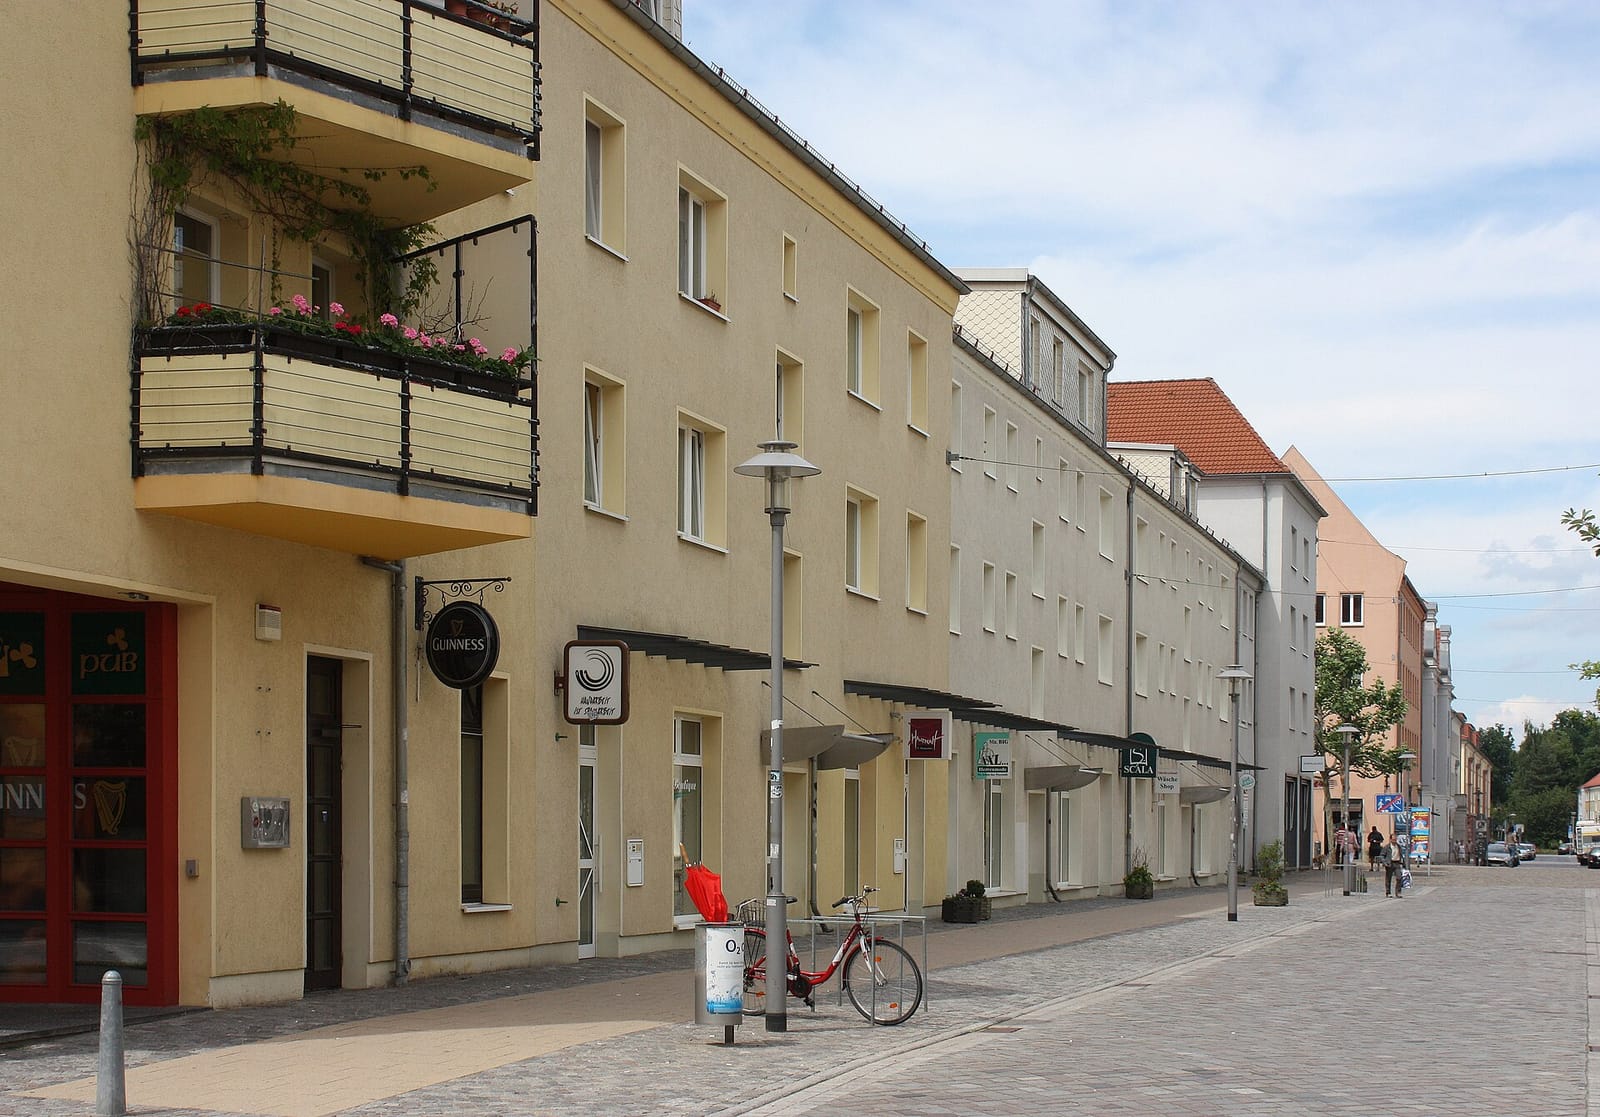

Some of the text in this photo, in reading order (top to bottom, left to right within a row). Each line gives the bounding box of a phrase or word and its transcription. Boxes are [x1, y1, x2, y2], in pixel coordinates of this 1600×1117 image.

[432, 637, 485, 651] GUINNESS
[1123, 765, 1154, 774] SCALA
[1159, 783, 1175, 791] Shop
